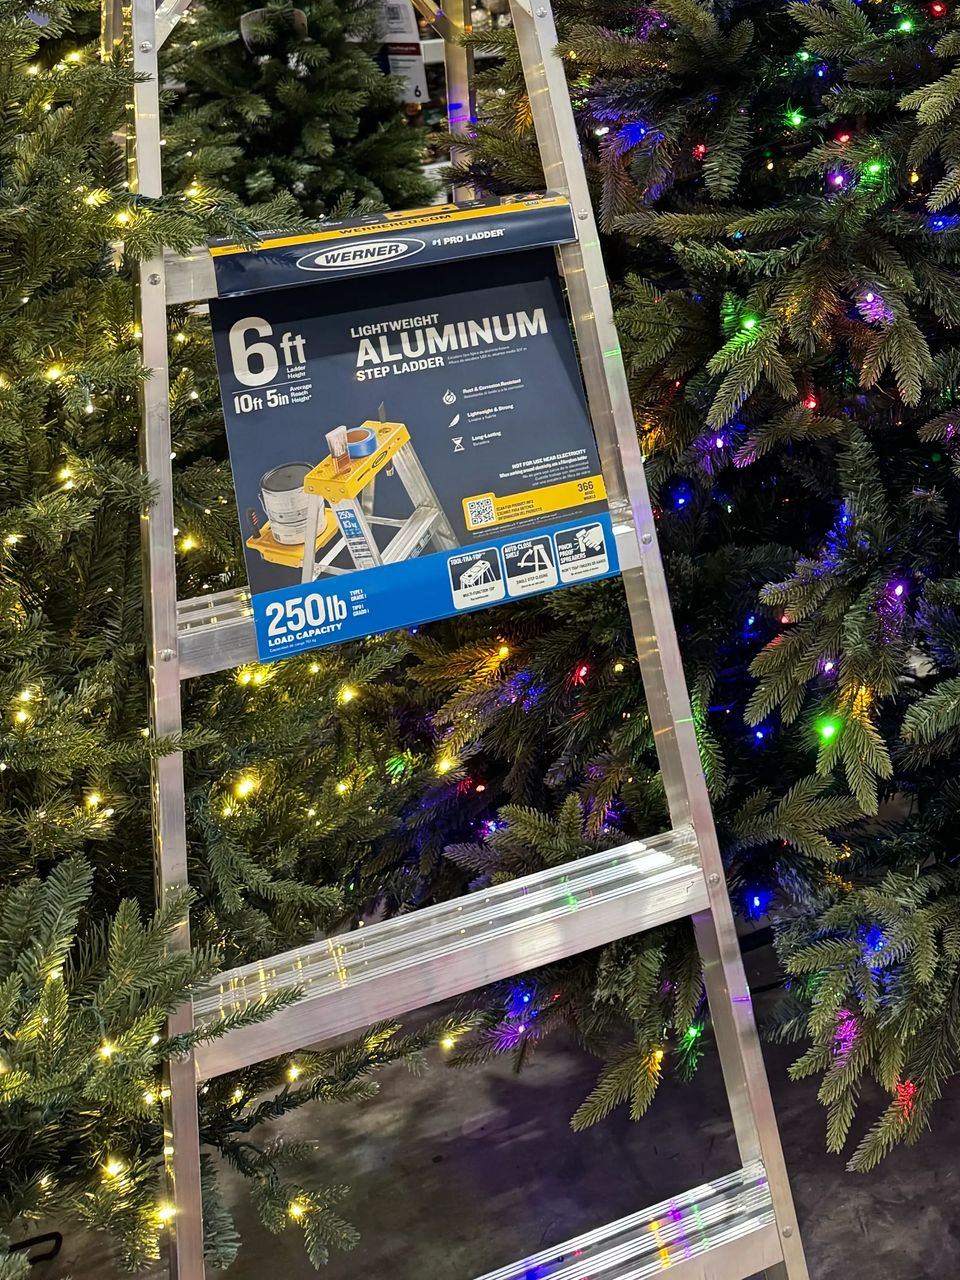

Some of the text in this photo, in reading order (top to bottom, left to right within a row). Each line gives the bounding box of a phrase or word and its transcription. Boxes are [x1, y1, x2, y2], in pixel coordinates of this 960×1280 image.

[339, 214, 452, 235] WERNERCO.COM
[324, 244, 401, 265] WERNER
[444, 234, 463, 245] PRO
[465, 230, 505, 242] LADDER
[351, 314, 439, 338] LIGHTWEIGHT
[356, 307, 548, 367] ALUMINUM
[286, 365, 306, 373] Ladder
[288, 371, 306, 379] Height
[356, 356, 445, 382] STEP LADDER
[290, 383, 312, 392] Average
[291, 390, 309, 398] Reach
[467, 408, 493, 418] Lightweight
[498, 404, 514, 412] Strong
[557, 449, 586, 459] ELECTRICITY
[577, 481, 594, 493] 366
[504, 541, 533, 553] AUTO-CLOSE
[558, 543, 572, 551] PINCH
[505, 551, 520, 559] SHELF
[560, 553, 586, 564] SPREADERS
[268, 622, 343, 647] LOAD CAPACITY
